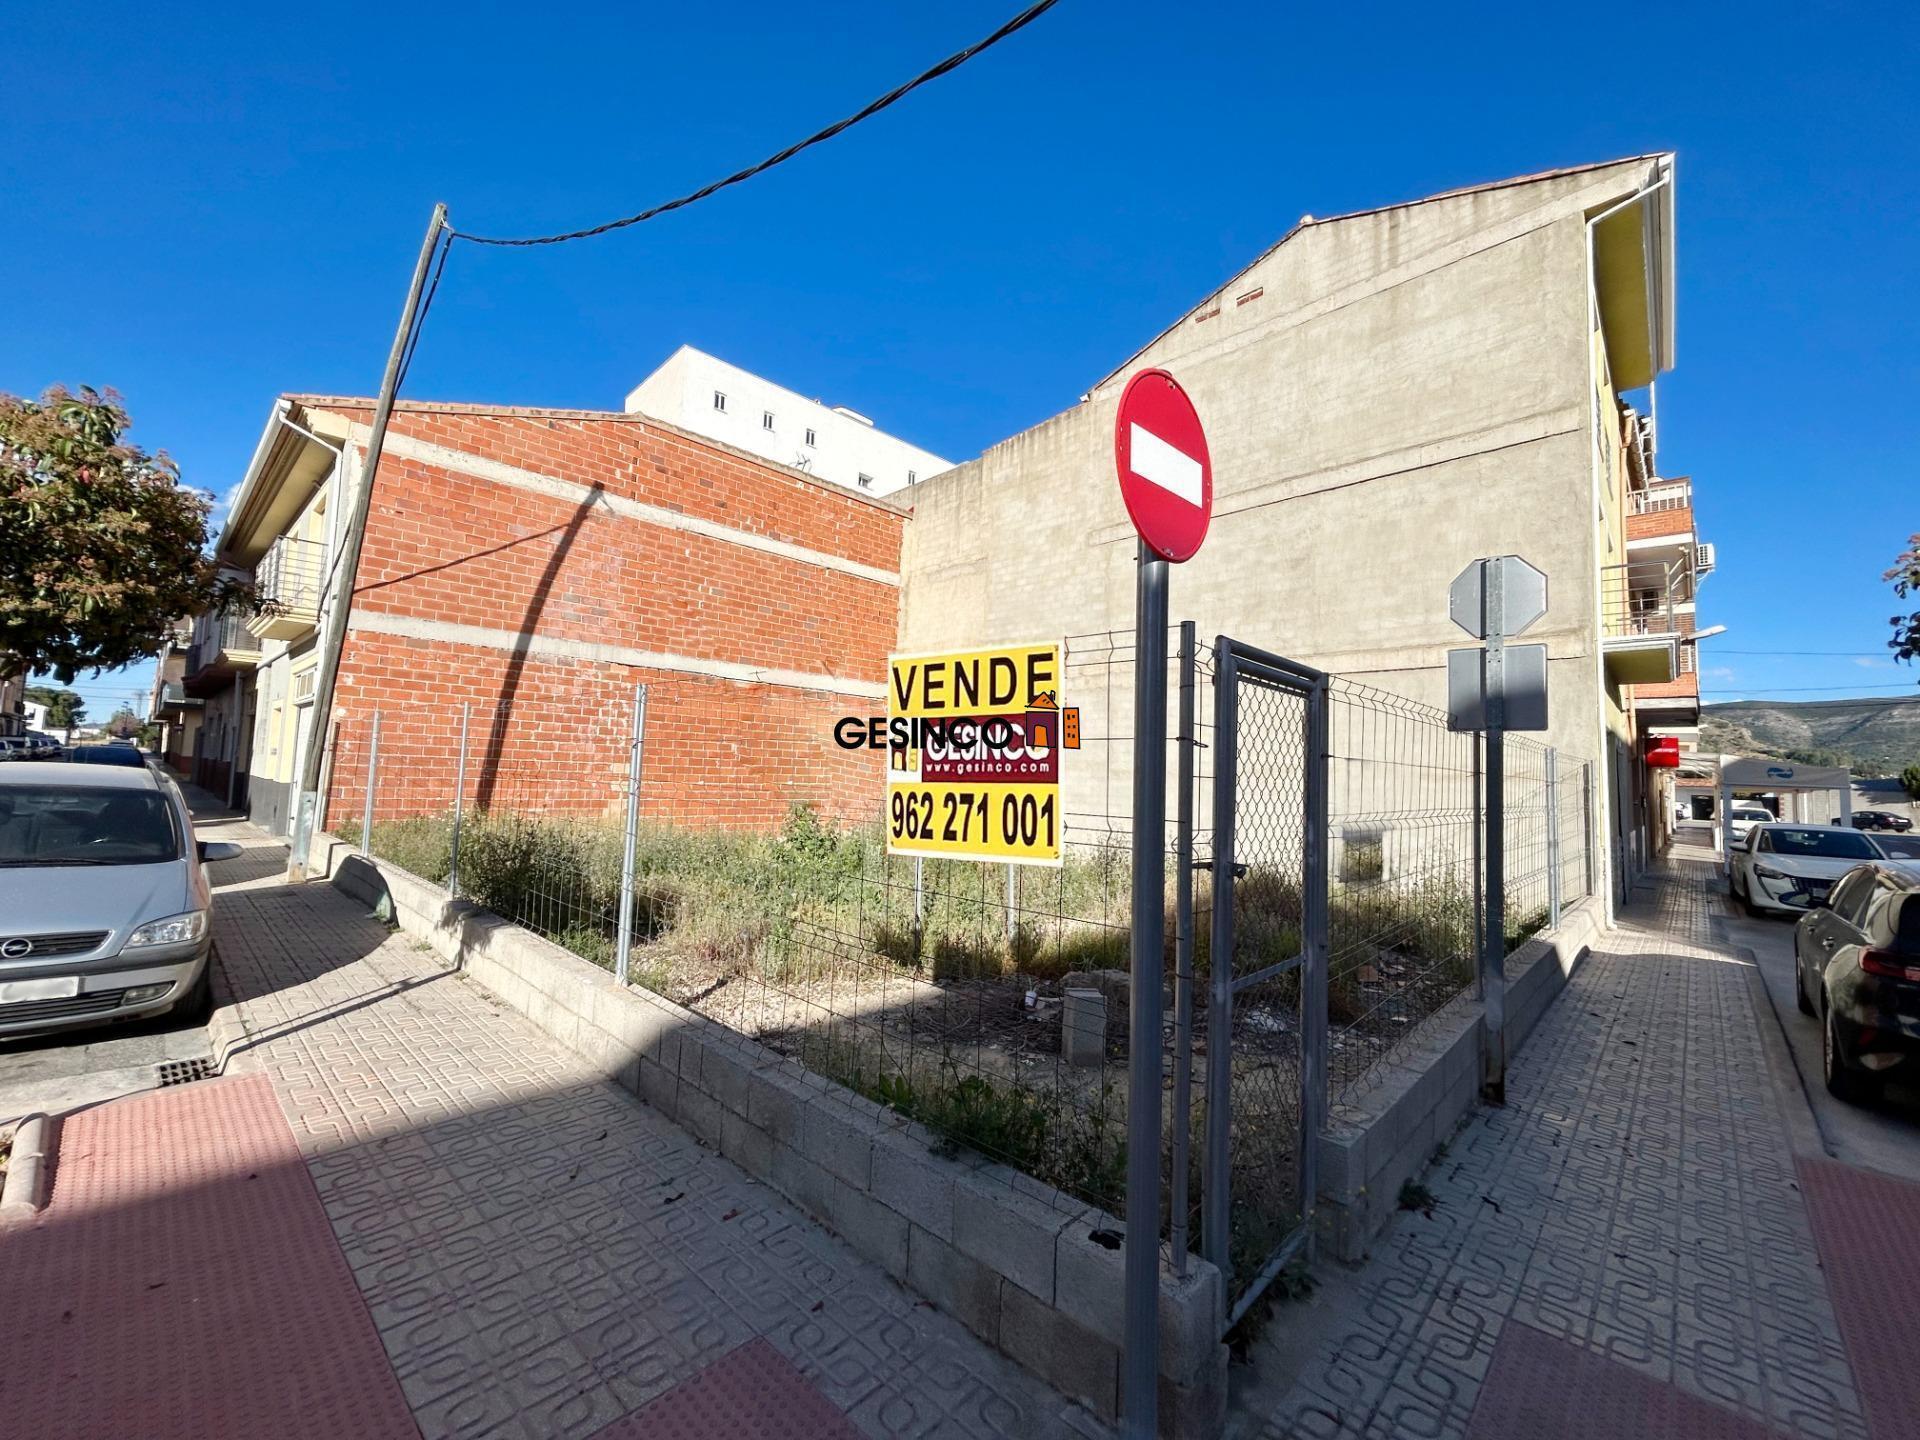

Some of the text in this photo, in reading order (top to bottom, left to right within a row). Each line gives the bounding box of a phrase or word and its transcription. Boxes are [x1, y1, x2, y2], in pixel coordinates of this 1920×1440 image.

[892, 652, 1054, 711] VENDE
[925, 761, 1050, 775] www.gesinco.com
[892, 791, 1054, 847] 962 271 001
